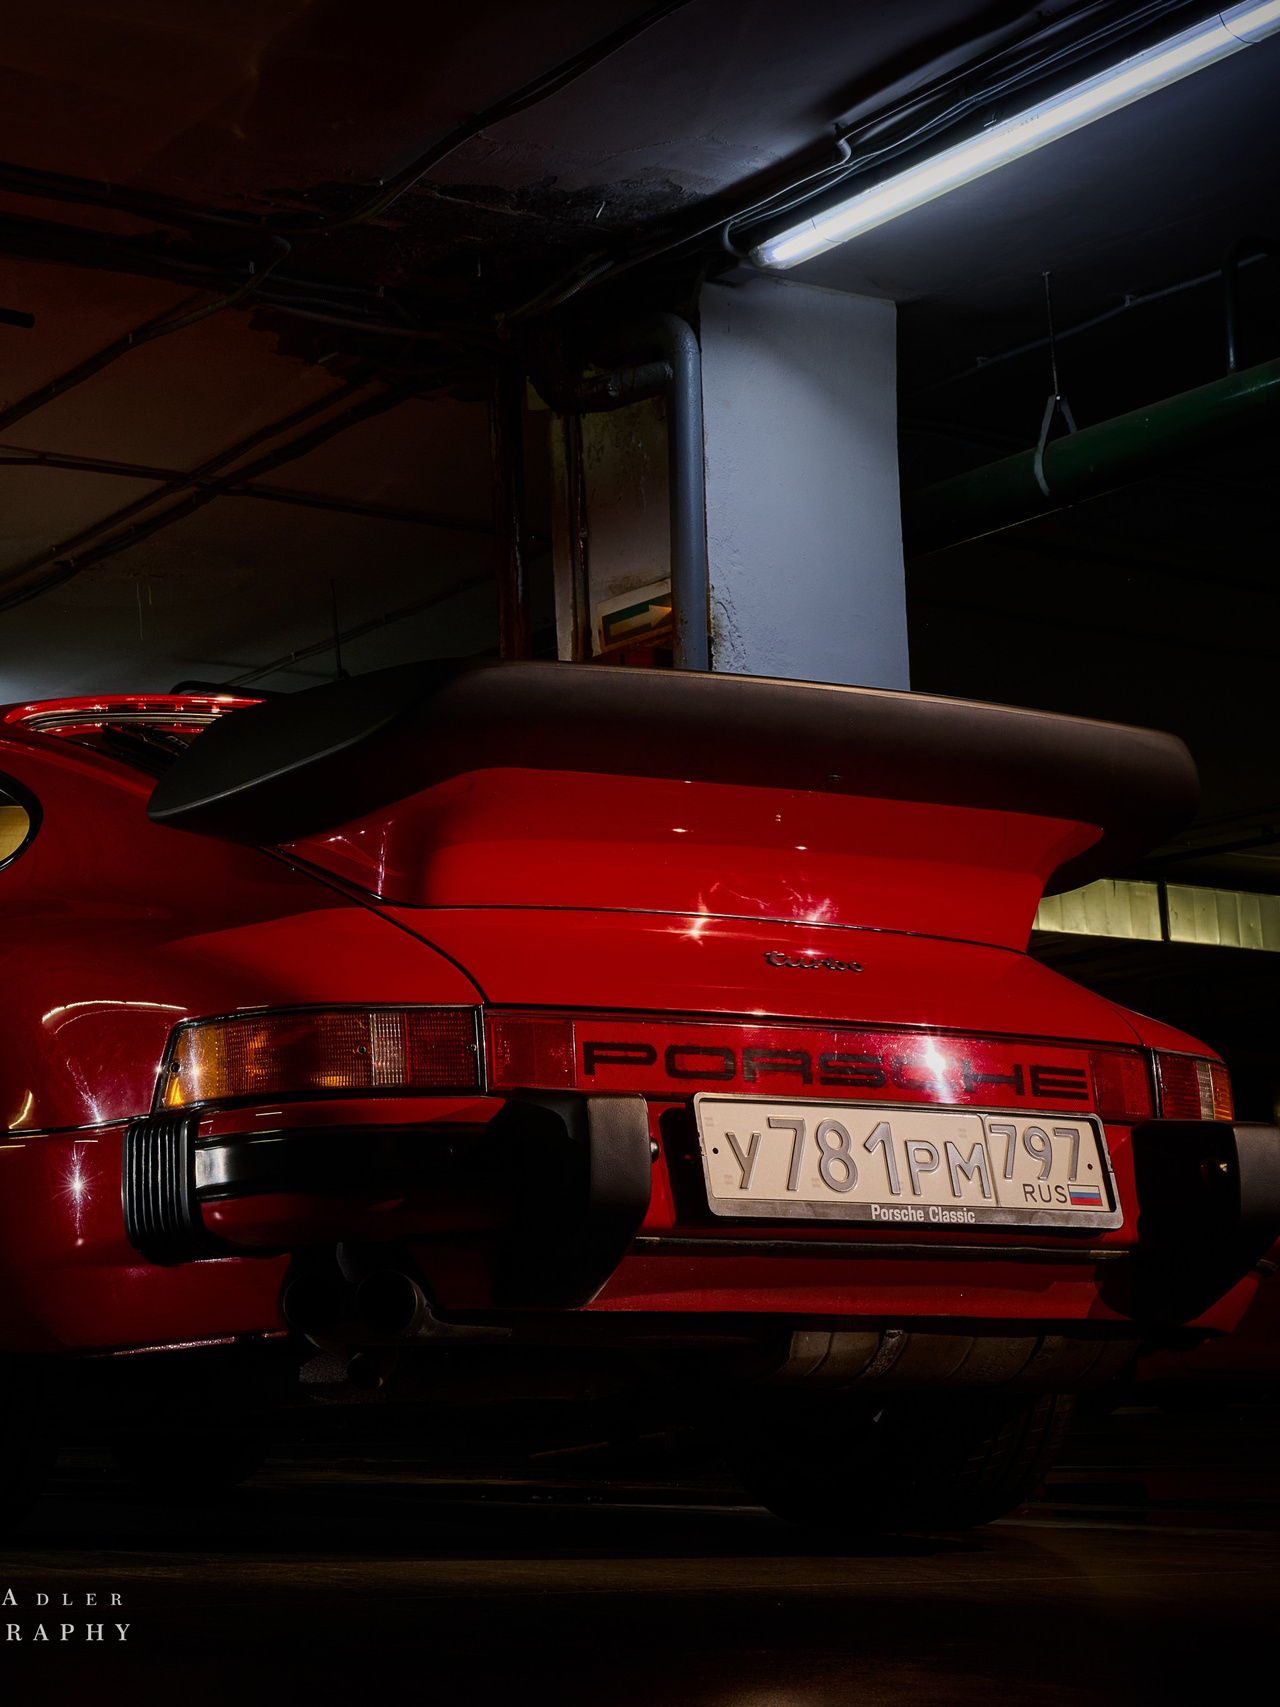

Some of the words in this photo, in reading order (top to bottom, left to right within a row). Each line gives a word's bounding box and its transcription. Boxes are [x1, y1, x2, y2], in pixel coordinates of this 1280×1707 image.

[762, 951, 864, 973] turbo
[582, 1041, 1089, 1100] PORSCHE
[989, 1124, 1080, 1181] 797
[1023, 1183, 1067, 1204] RUS
[871, 1205, 924, 1221] Porsche
[929, 1207, 976, 1223] Classic
